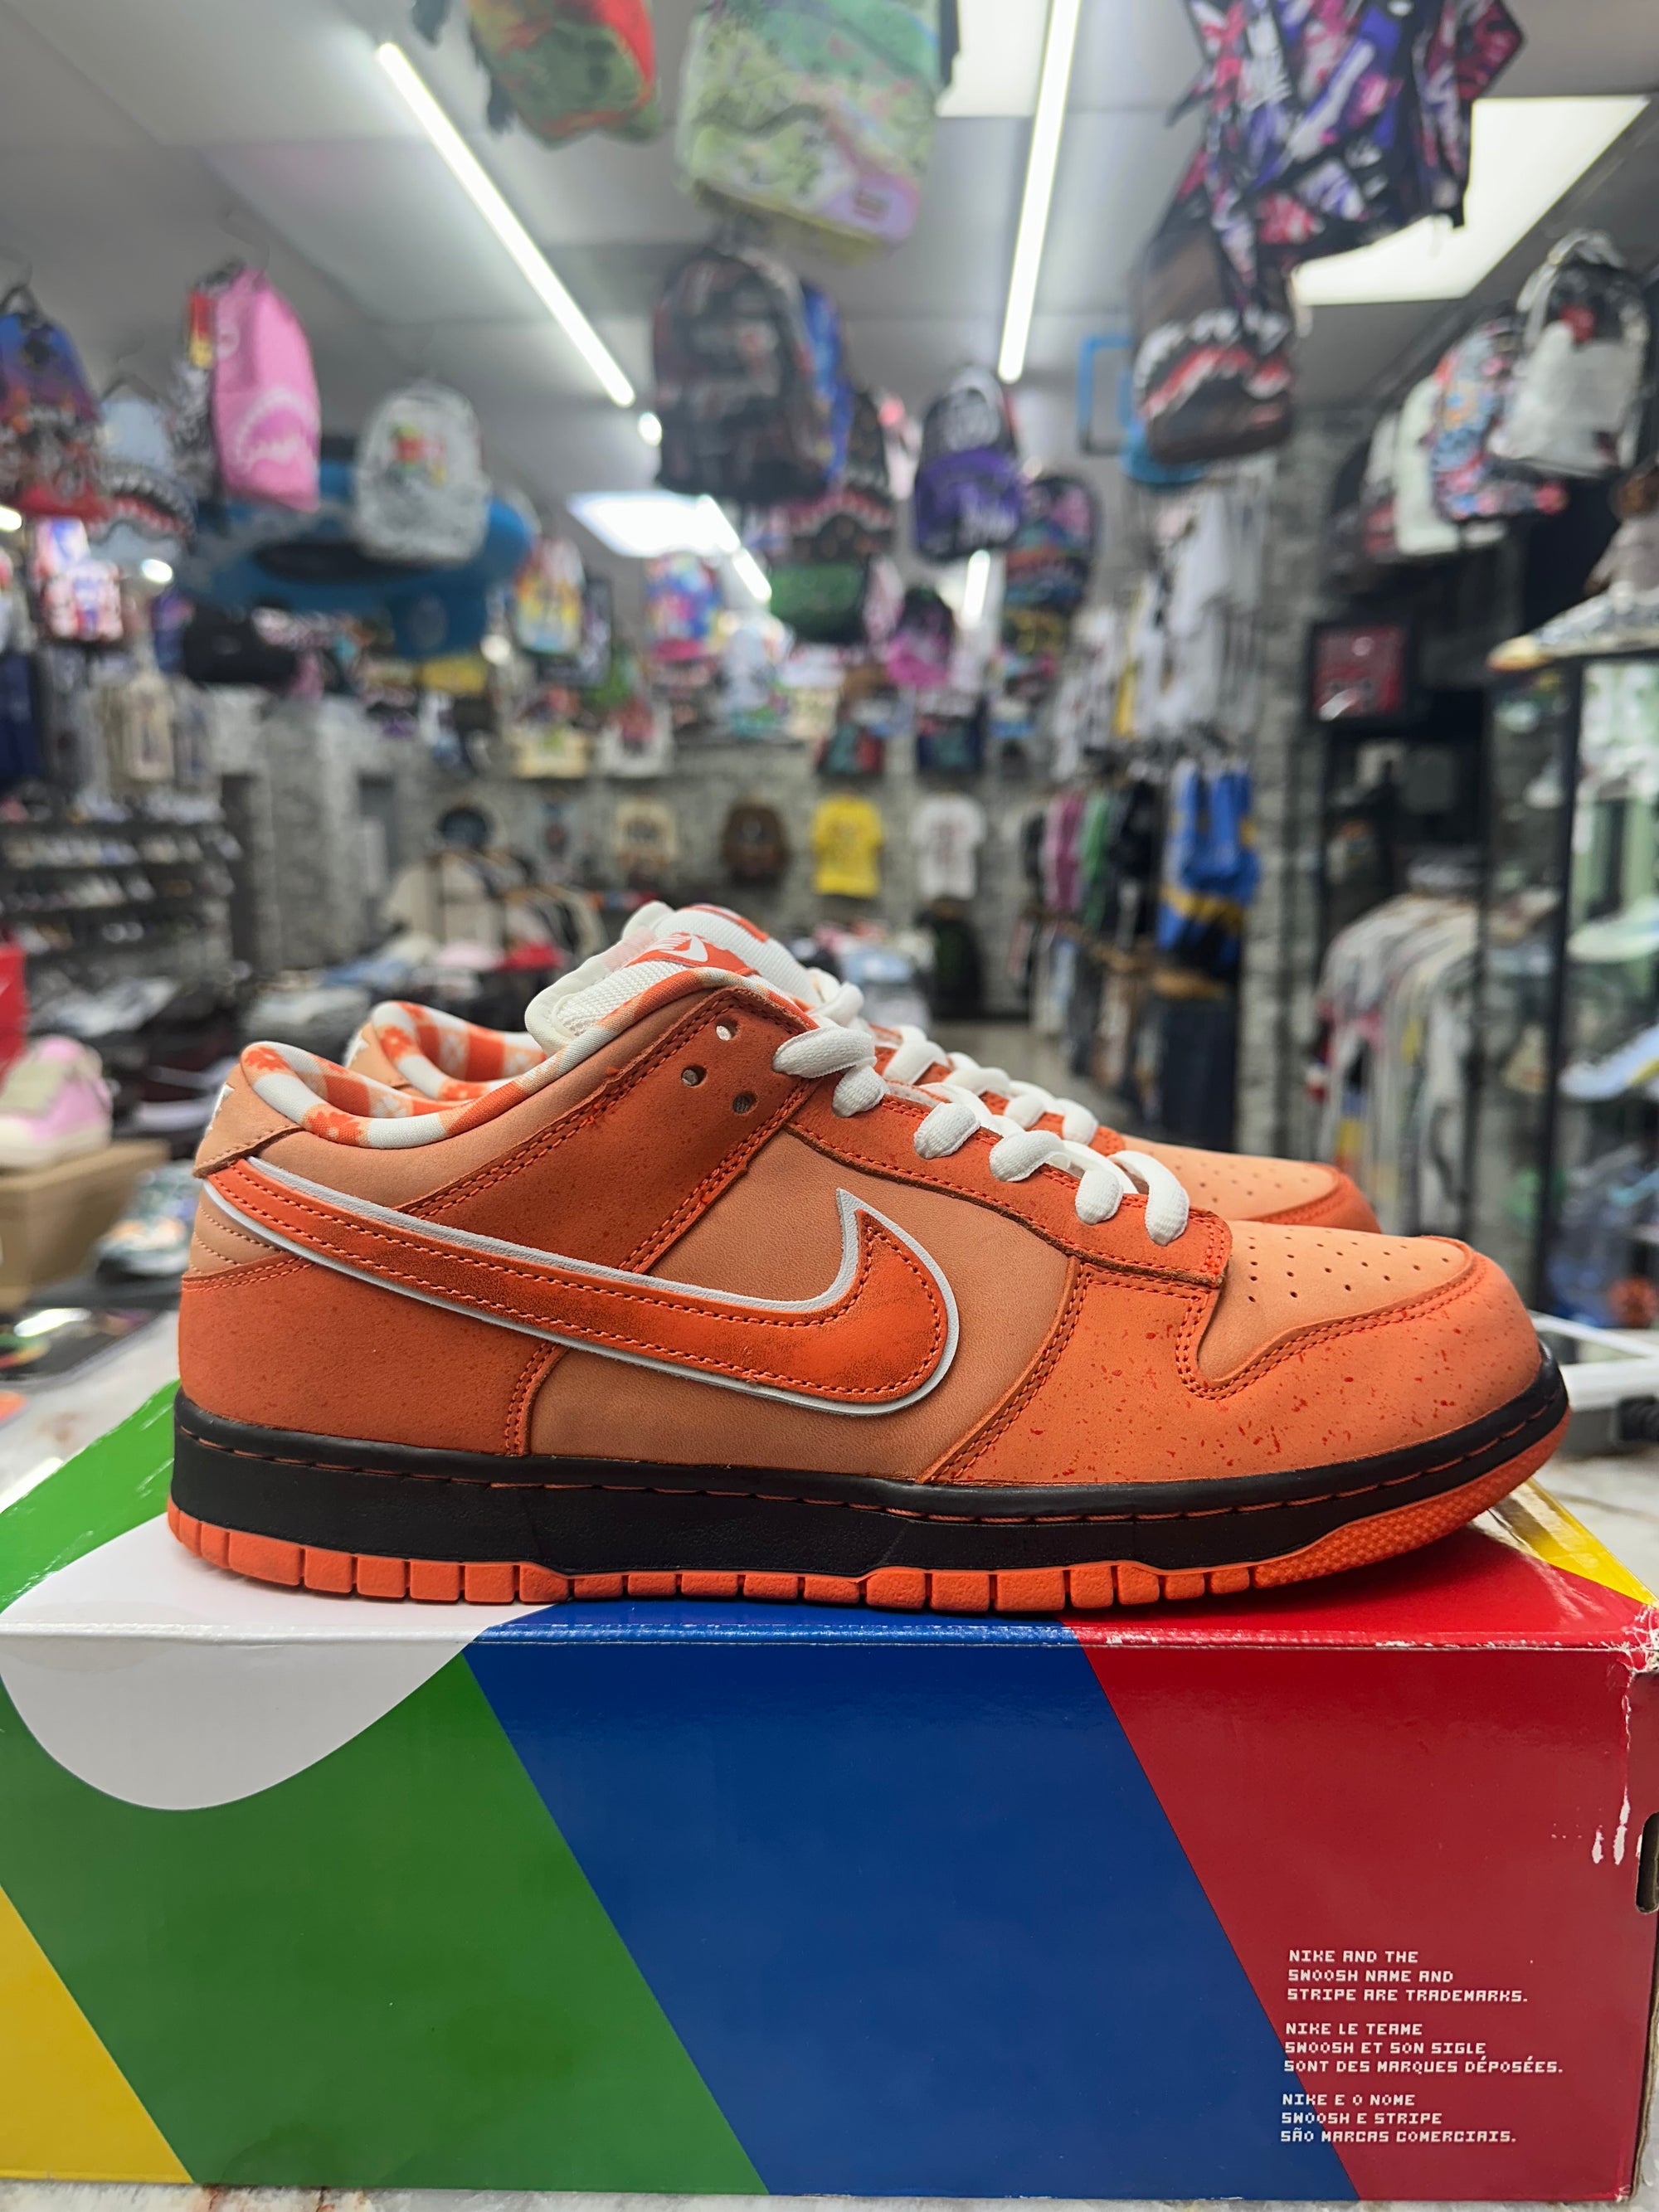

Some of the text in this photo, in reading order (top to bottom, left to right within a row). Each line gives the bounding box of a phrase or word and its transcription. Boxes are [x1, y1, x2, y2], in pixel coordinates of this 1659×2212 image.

[1289, 1949, 1418, 1963] NIKE AND THE
[1288, 1969, 1453, 1983] SWOOSH NAME AND
[1287, 1988, 1528, 2002] STRIPE ARE TRADEMARKS.
[1286, 2022, 1331, 2035] NIKE
[1339, 2023, 1359, 2035] LE
[1285, 2041, 1486, 2054] SWOOSH ET SON SIGLE
[1284, 2055, 1563, 2075] SONT DES MARQUES DÉPOSÉES.
[1282, 2093, 1415, 2106] NIKE E O NOME
[1282, 2112, 1443, 2125] SWOOSH E STRIPE
[1280, 2127, 1516, 2142] SÃO MARCAS COMERCIAIS.
